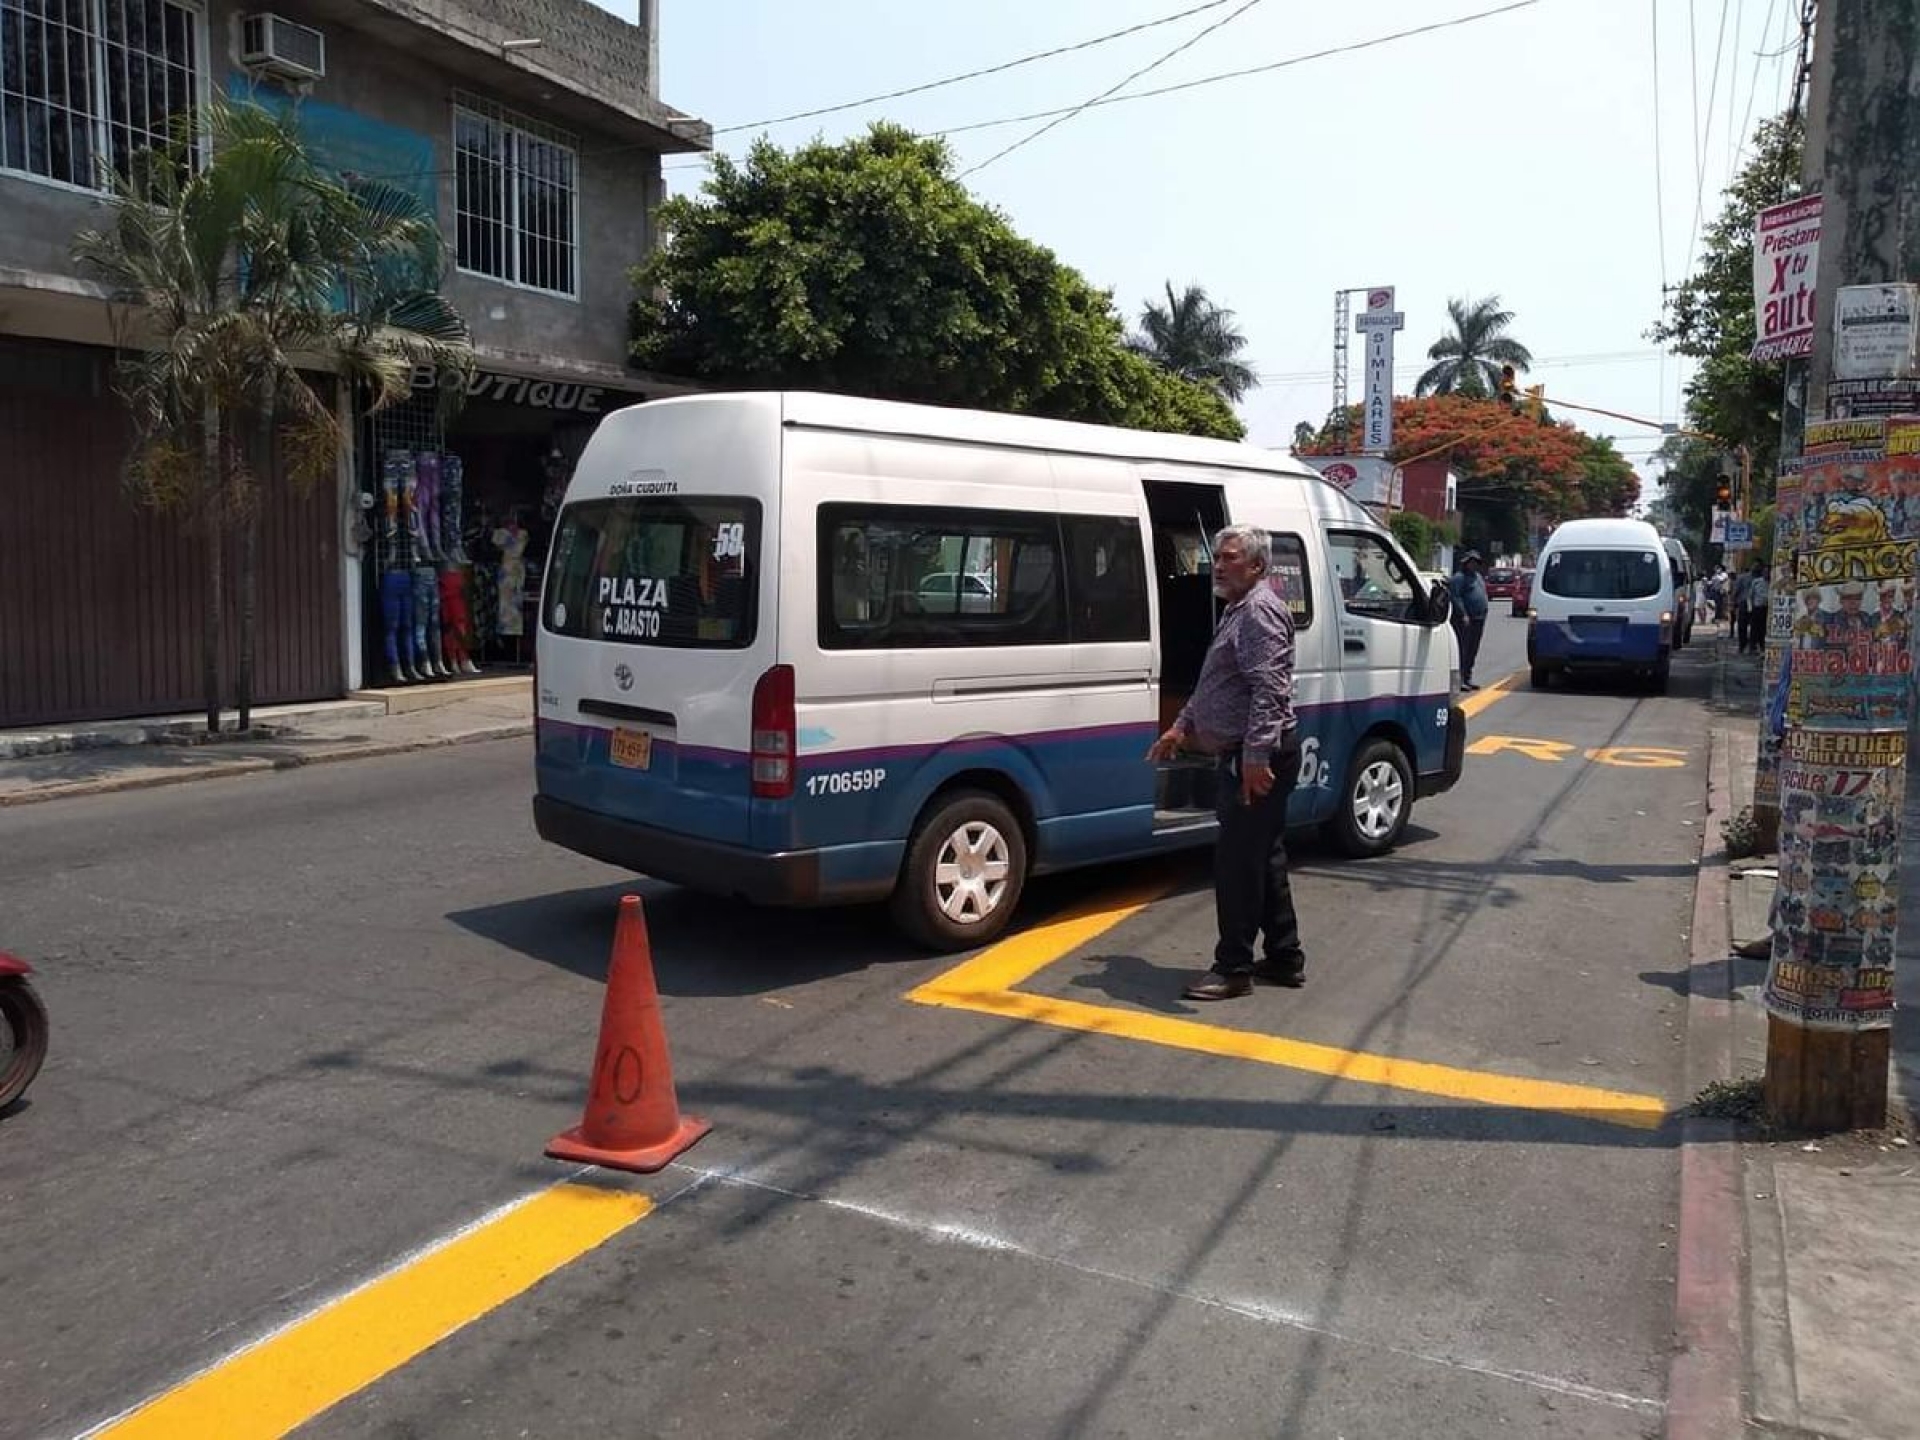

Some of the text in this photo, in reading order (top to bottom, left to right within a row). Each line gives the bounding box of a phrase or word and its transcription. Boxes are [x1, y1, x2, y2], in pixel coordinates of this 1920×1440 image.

[1769, 254, 1792, 295] X
[409, 363, 604, 412] BOUTIQUE
[1369, 332, 1386, 444] SIMILARES
[599, 577, 669, 608] PLAZA
[602, 608, 660, 638] C. ABASTO
[806, 768, 886, 796] 170659P
